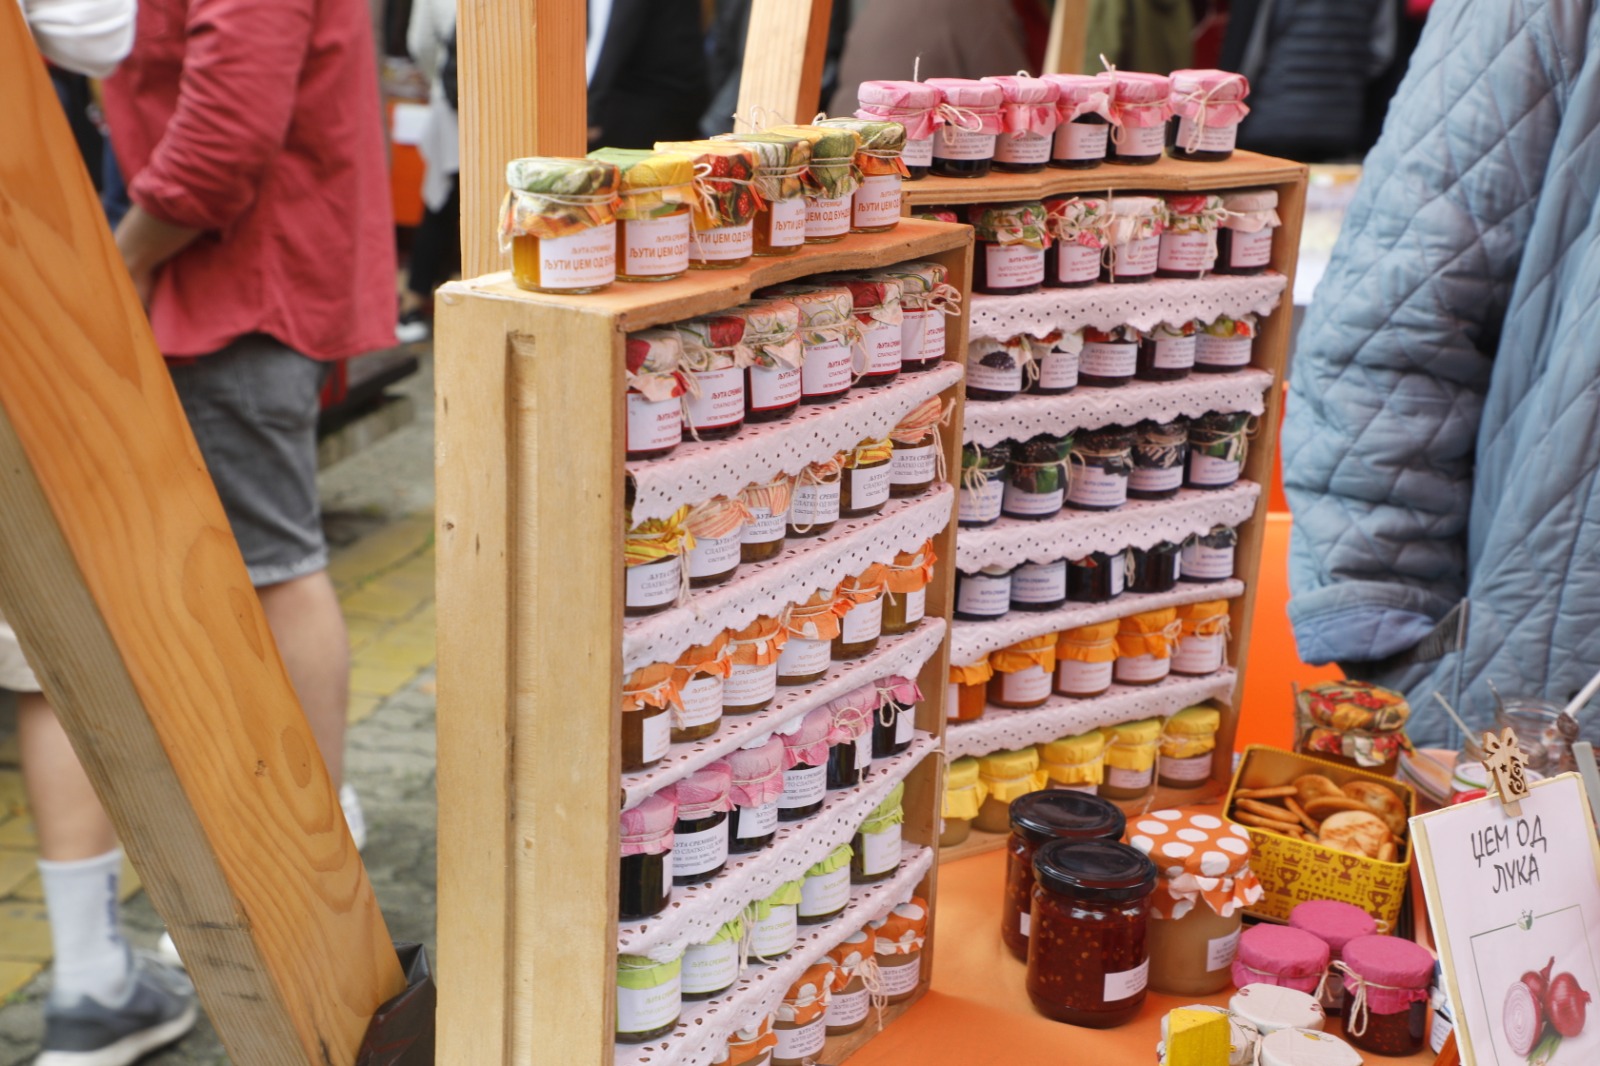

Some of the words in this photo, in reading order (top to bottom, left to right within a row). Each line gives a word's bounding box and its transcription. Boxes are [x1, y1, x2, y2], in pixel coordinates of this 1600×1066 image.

[857, 203, 878, 212] ЉУТИ
[713, 233, 730, 245] ЏЕМ
[732, 232, 742, 243] ОД
[629, 247, 655, 258] ЉУТИ
[657, 245, 673, 259] ЏЕМ
[544, 259, 570, 271] ЉУТИ
[572, 258, 592, 272] ЏЕМ
[1471, 824, 1509, 868] ЏЕМ
[1517, 814, 1547, 853] ОД
[1493, 853, 1540, 893] ЛУКА
